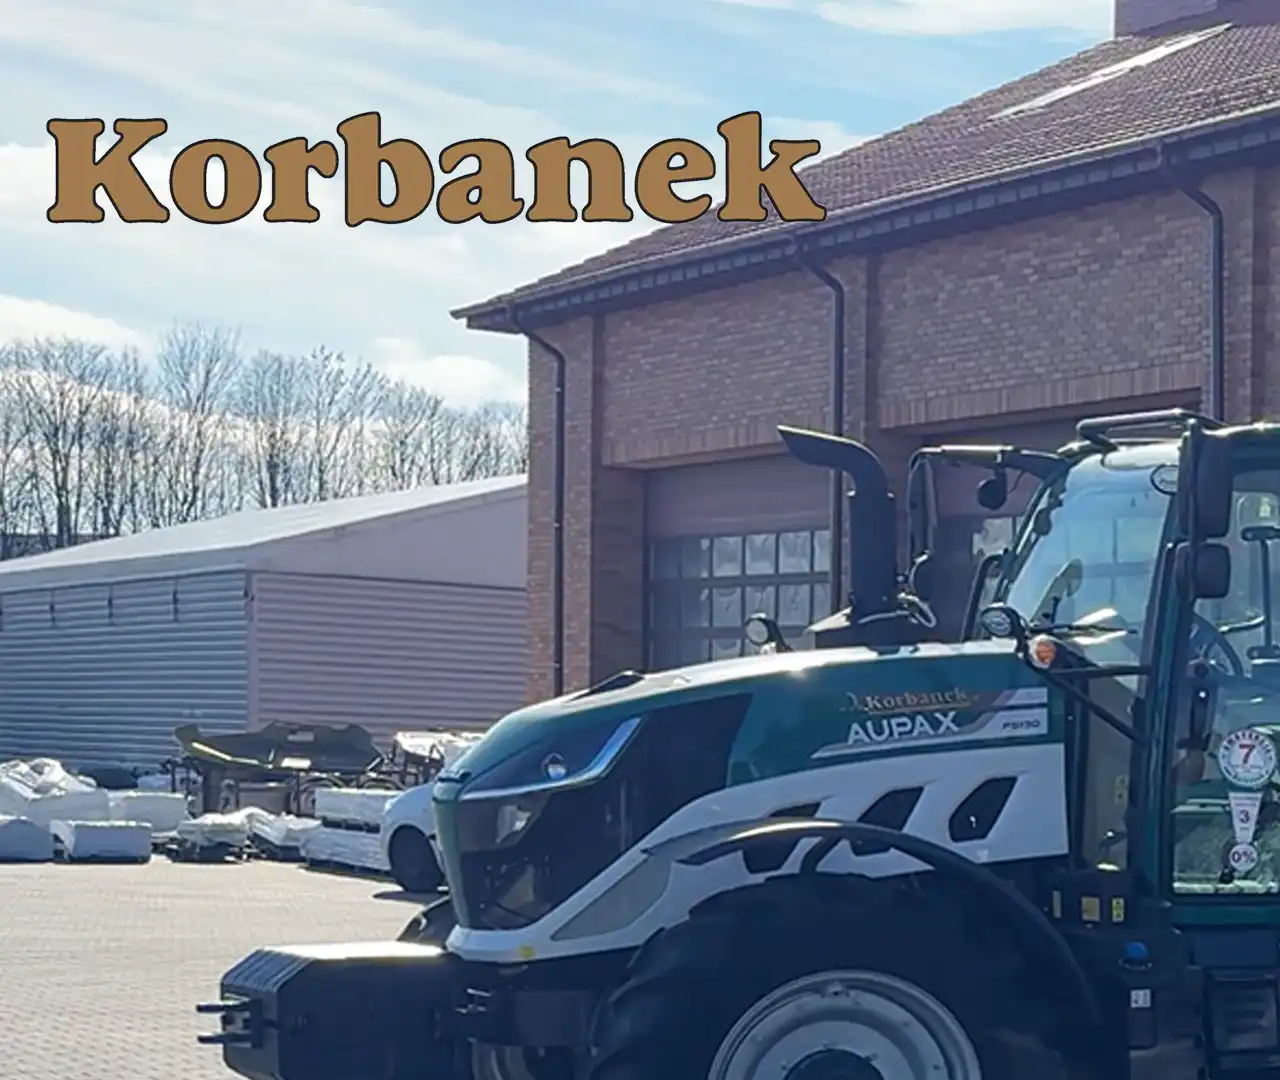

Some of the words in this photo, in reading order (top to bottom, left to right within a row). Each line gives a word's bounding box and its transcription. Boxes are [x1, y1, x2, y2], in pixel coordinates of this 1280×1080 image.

[847, 711, 960, 745] AUPAX
[1238, 743, 1255, 765] 7
[1238, 809, 1250, 824] 3
[1231, 850, 1256, 864] 0%
